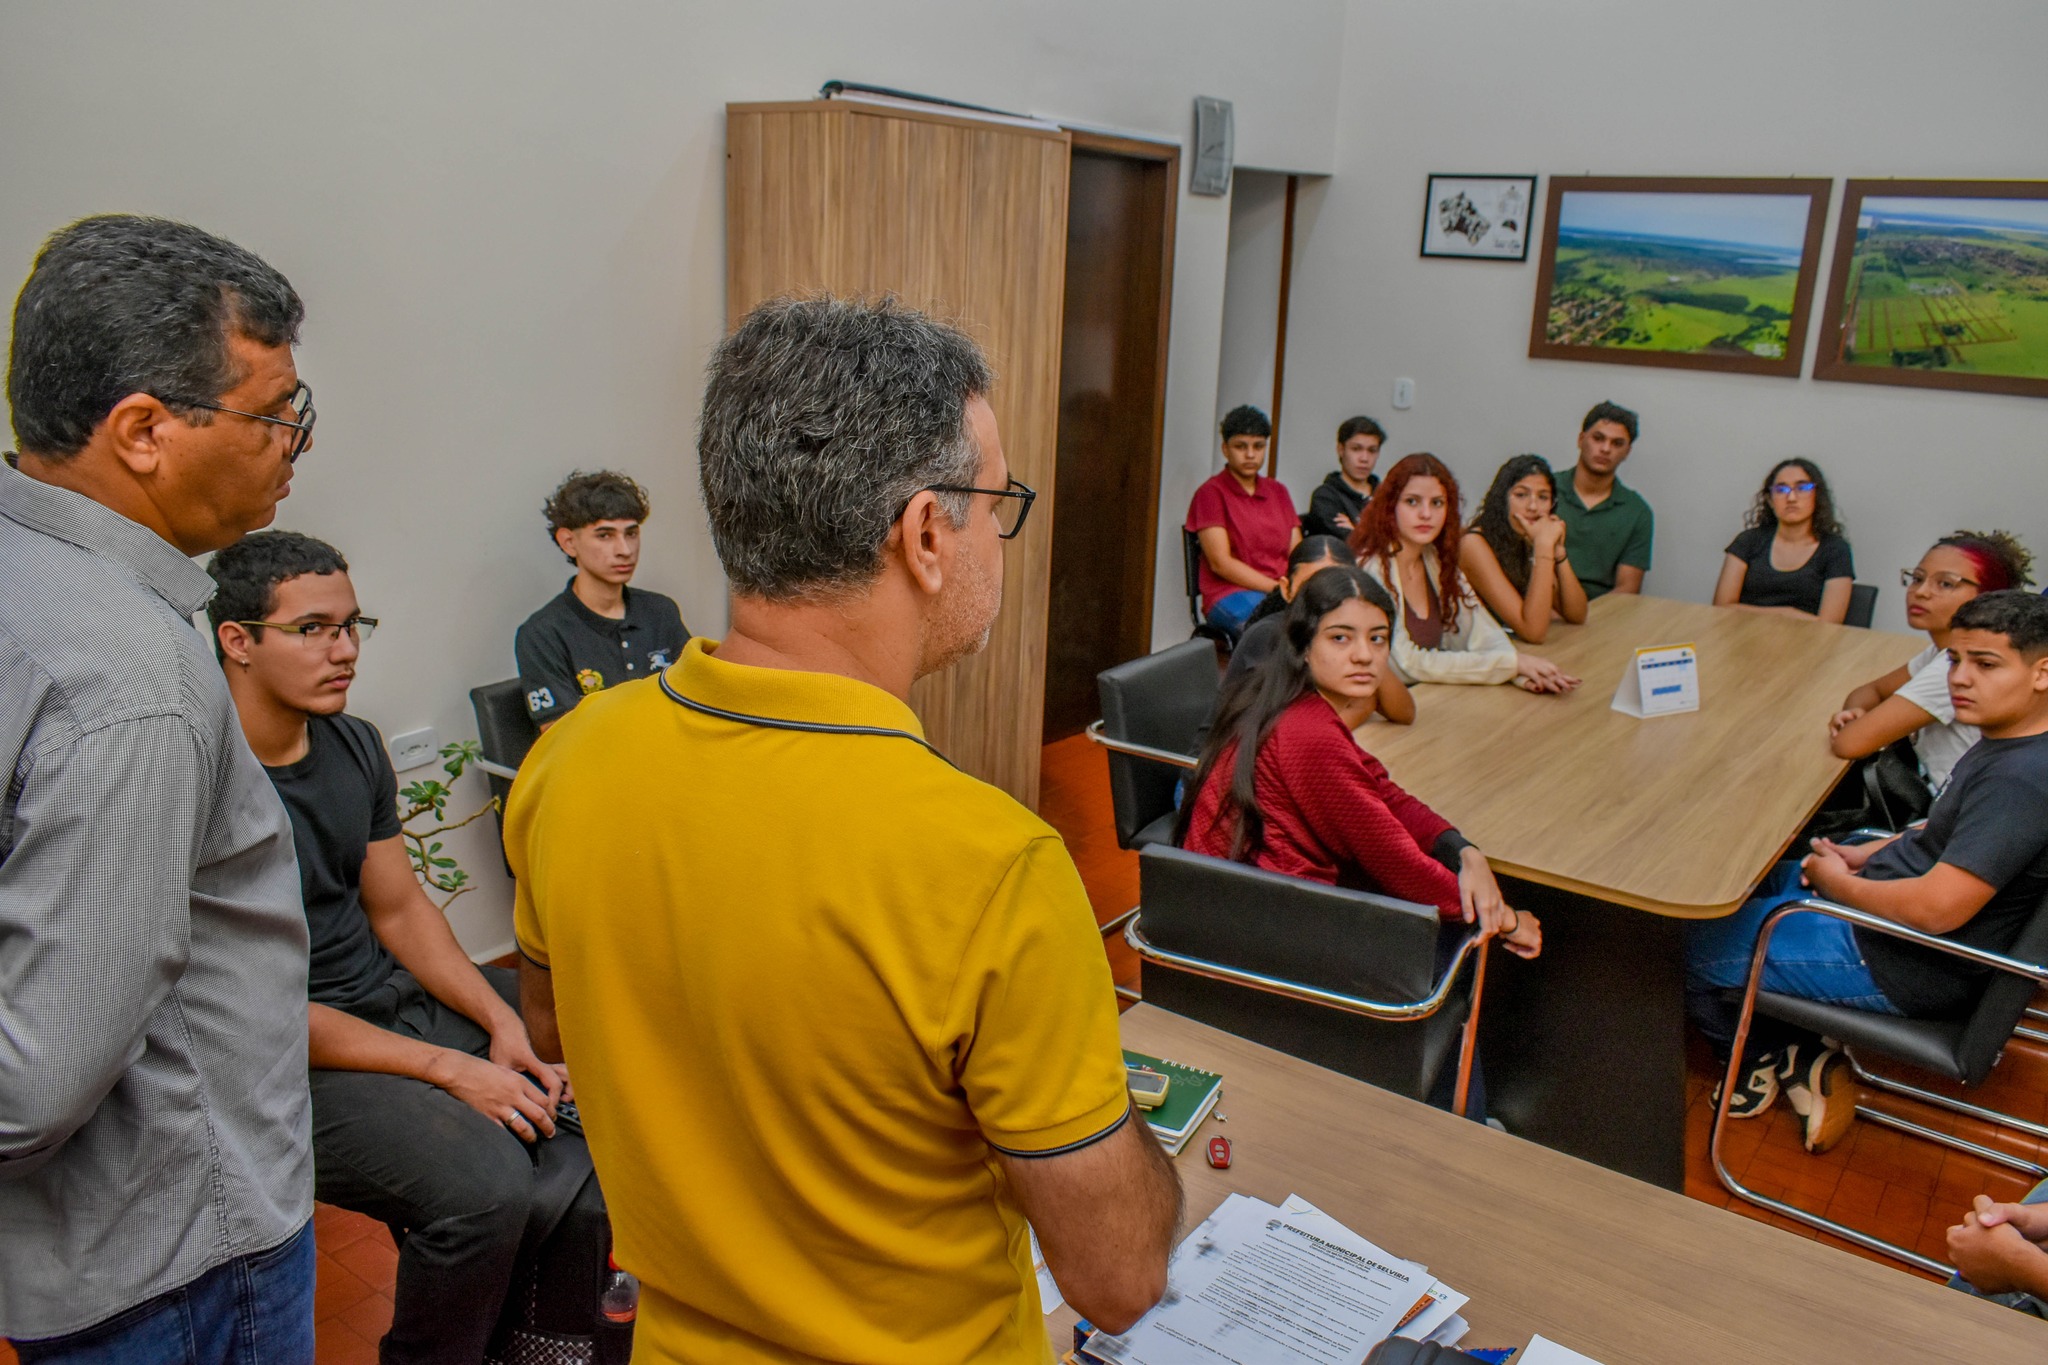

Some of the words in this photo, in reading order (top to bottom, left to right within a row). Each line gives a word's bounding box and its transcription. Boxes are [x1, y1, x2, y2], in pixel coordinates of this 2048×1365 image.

[527, 686, 555, 712] 63
[1283, 1223, 1325, 1245] PREFEITURA
[1325, 1242, 1366, 1262] MUNICIPAL
[1366, 1259, 1377, 1268] DE
